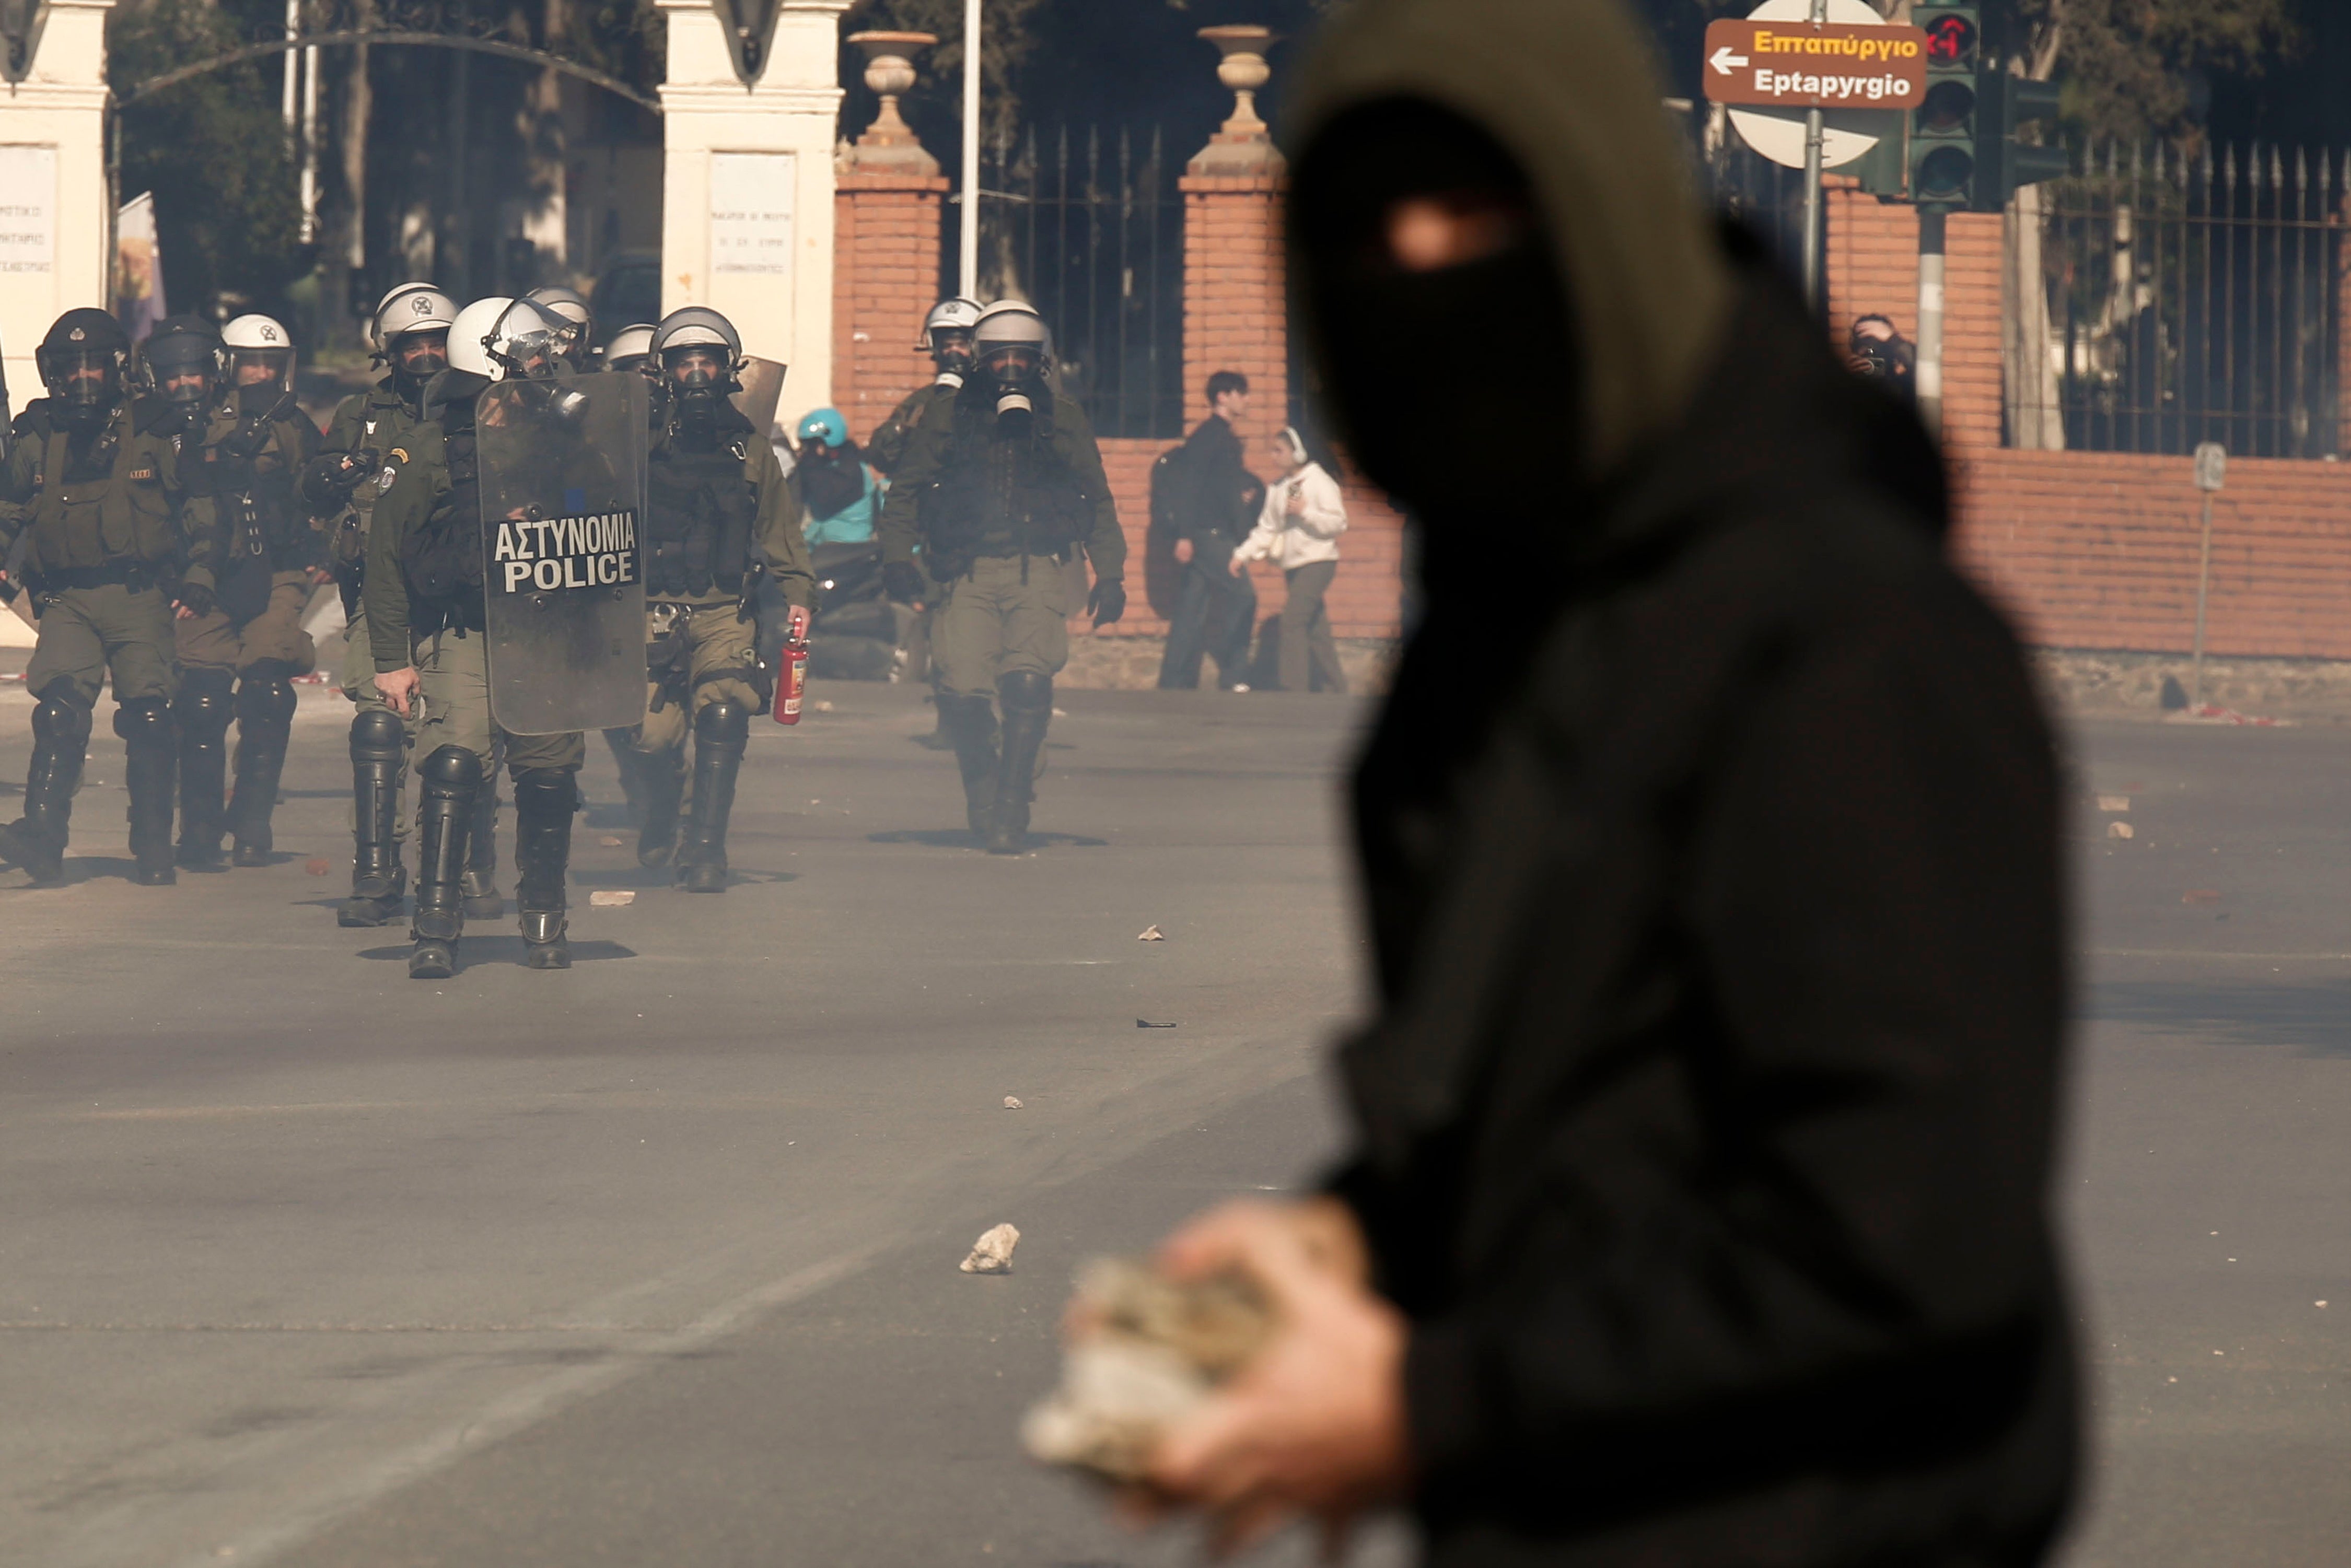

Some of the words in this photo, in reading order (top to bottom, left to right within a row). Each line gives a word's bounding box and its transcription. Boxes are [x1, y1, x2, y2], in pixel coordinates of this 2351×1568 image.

[1754, 30, 1918, 61] Επταπύργιο
[1754, 68, 1911, 100] Eptapyrgio
[495, 512, 635, 561] ΑΣΤΥΝΟΜΙΑ
[505, 552, 633, 592] POLICE
